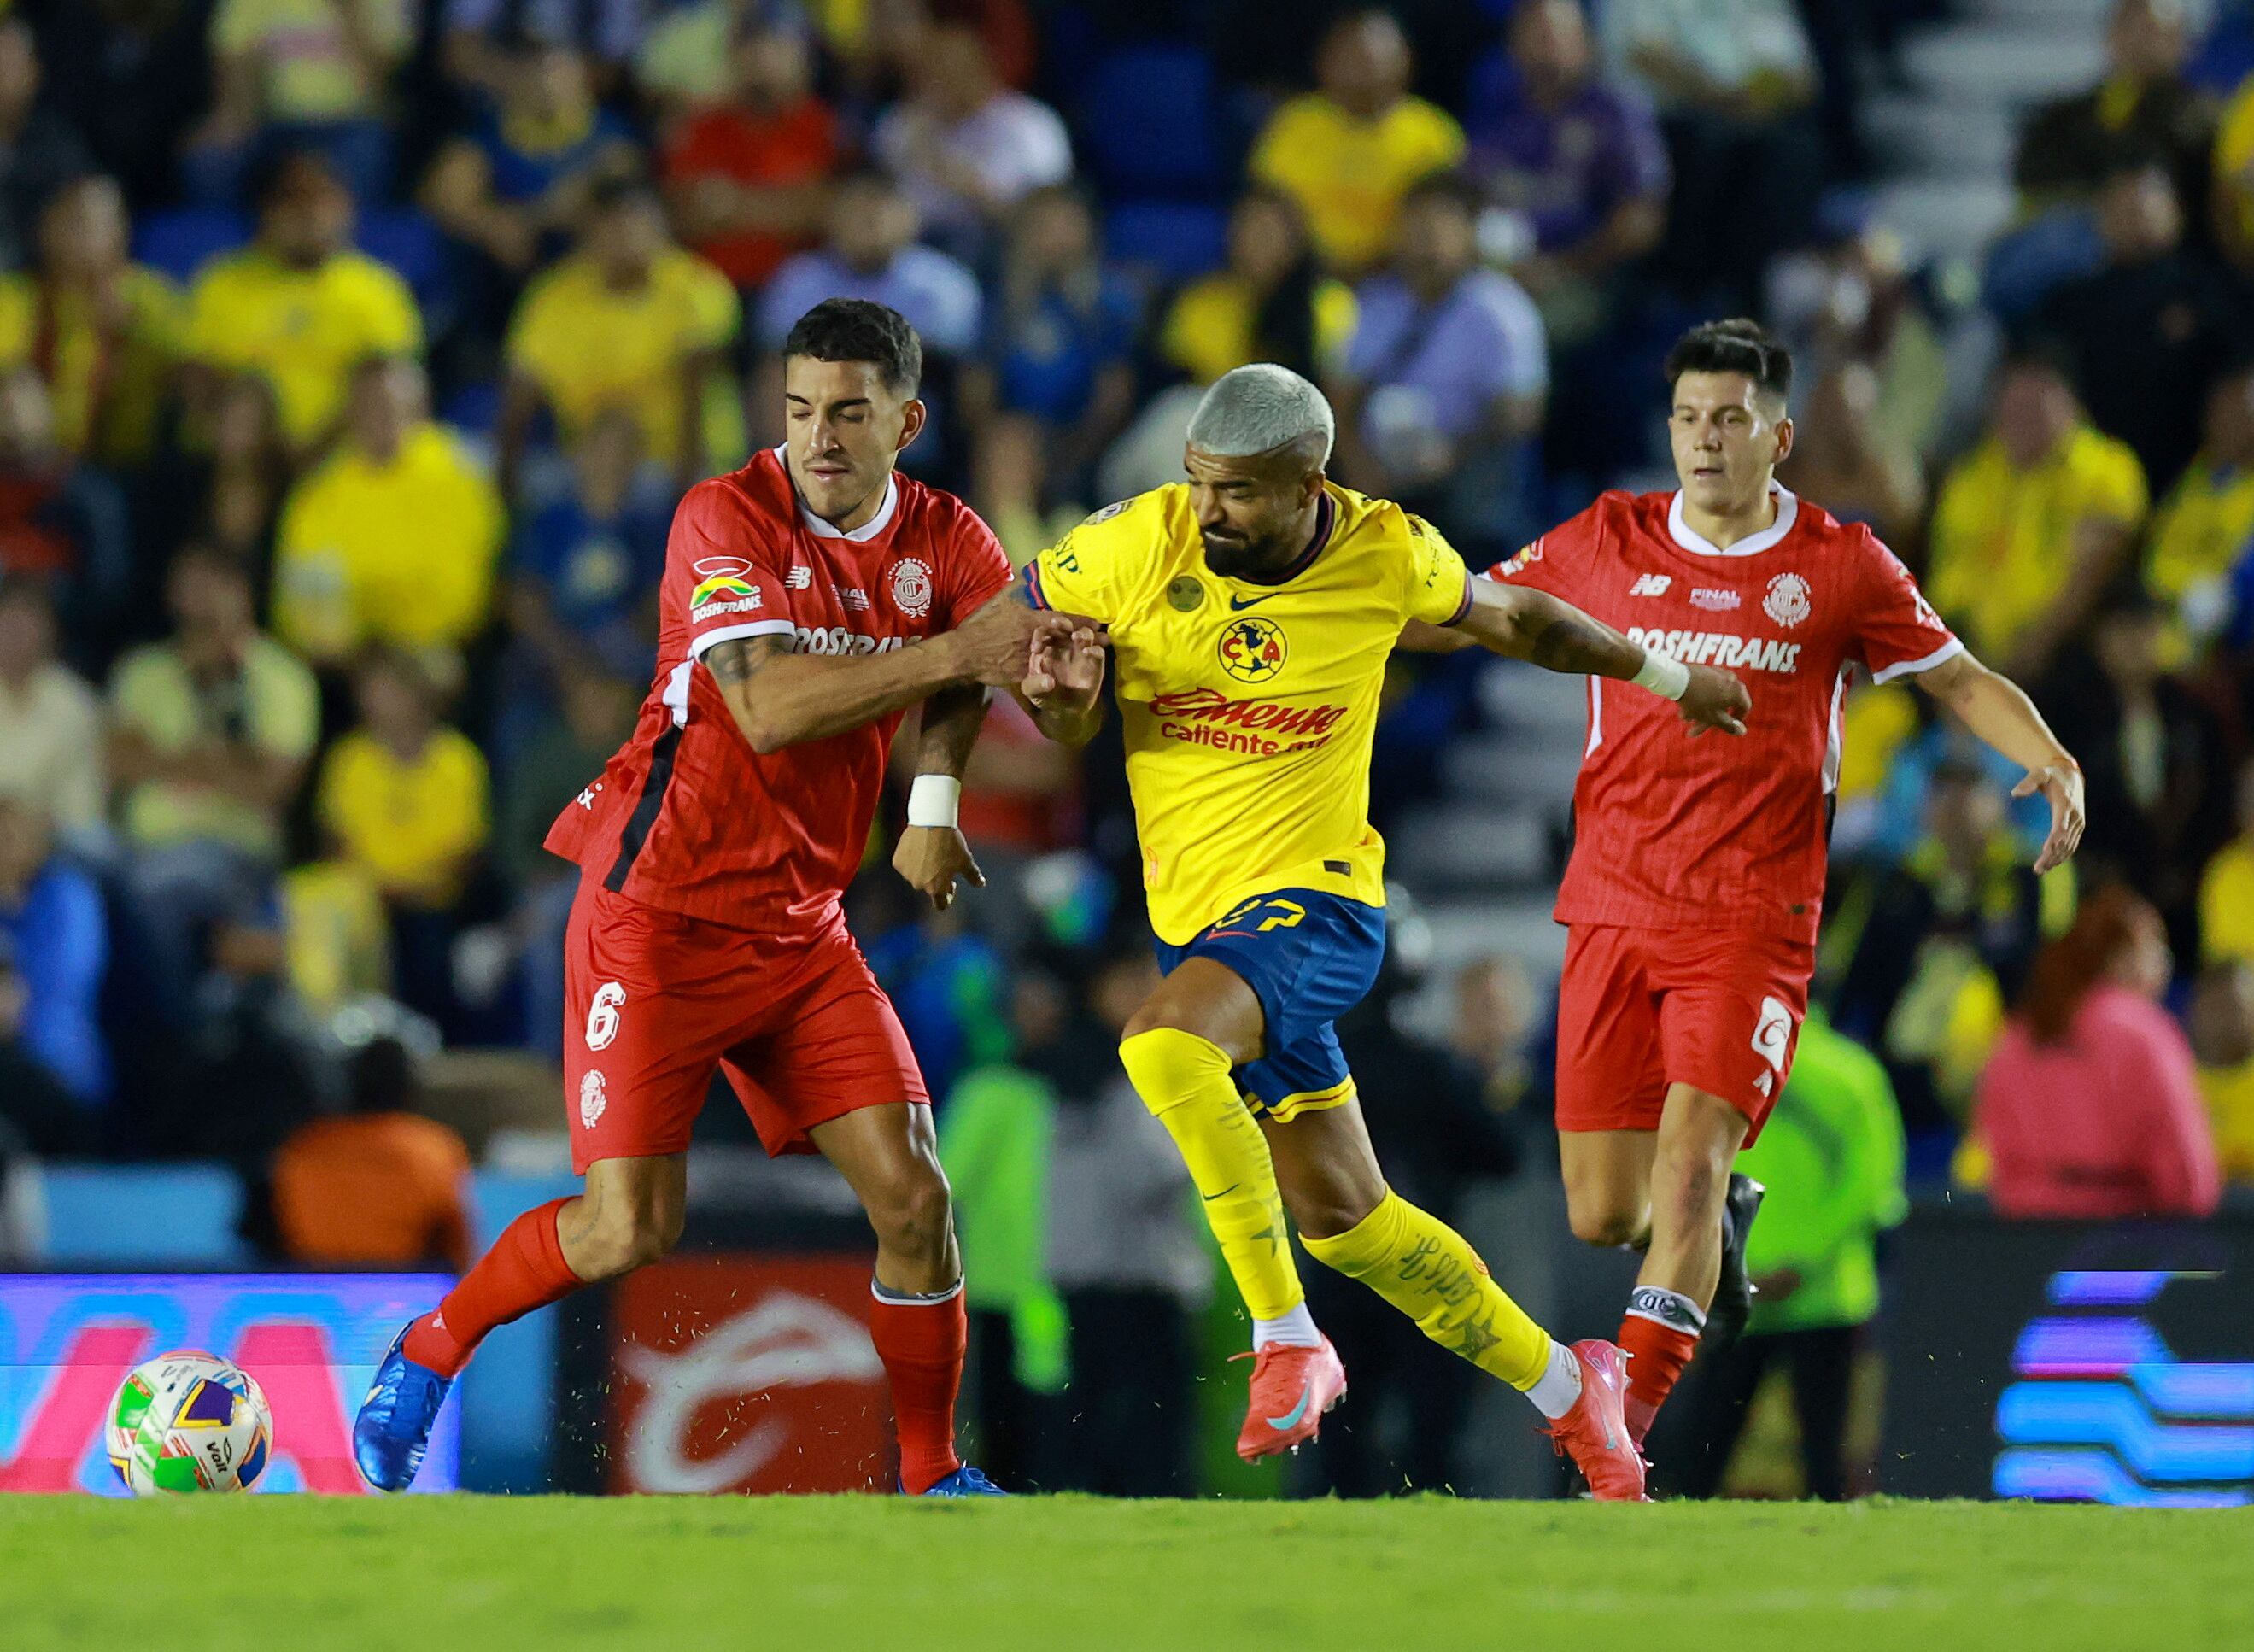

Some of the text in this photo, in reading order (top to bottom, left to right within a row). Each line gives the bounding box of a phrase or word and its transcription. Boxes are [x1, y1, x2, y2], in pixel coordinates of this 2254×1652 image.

[1629, 573, 1672, 596] NB
[1690, 588, 1740, 601] FINAL
[585, 981, 627, 1052] 6
